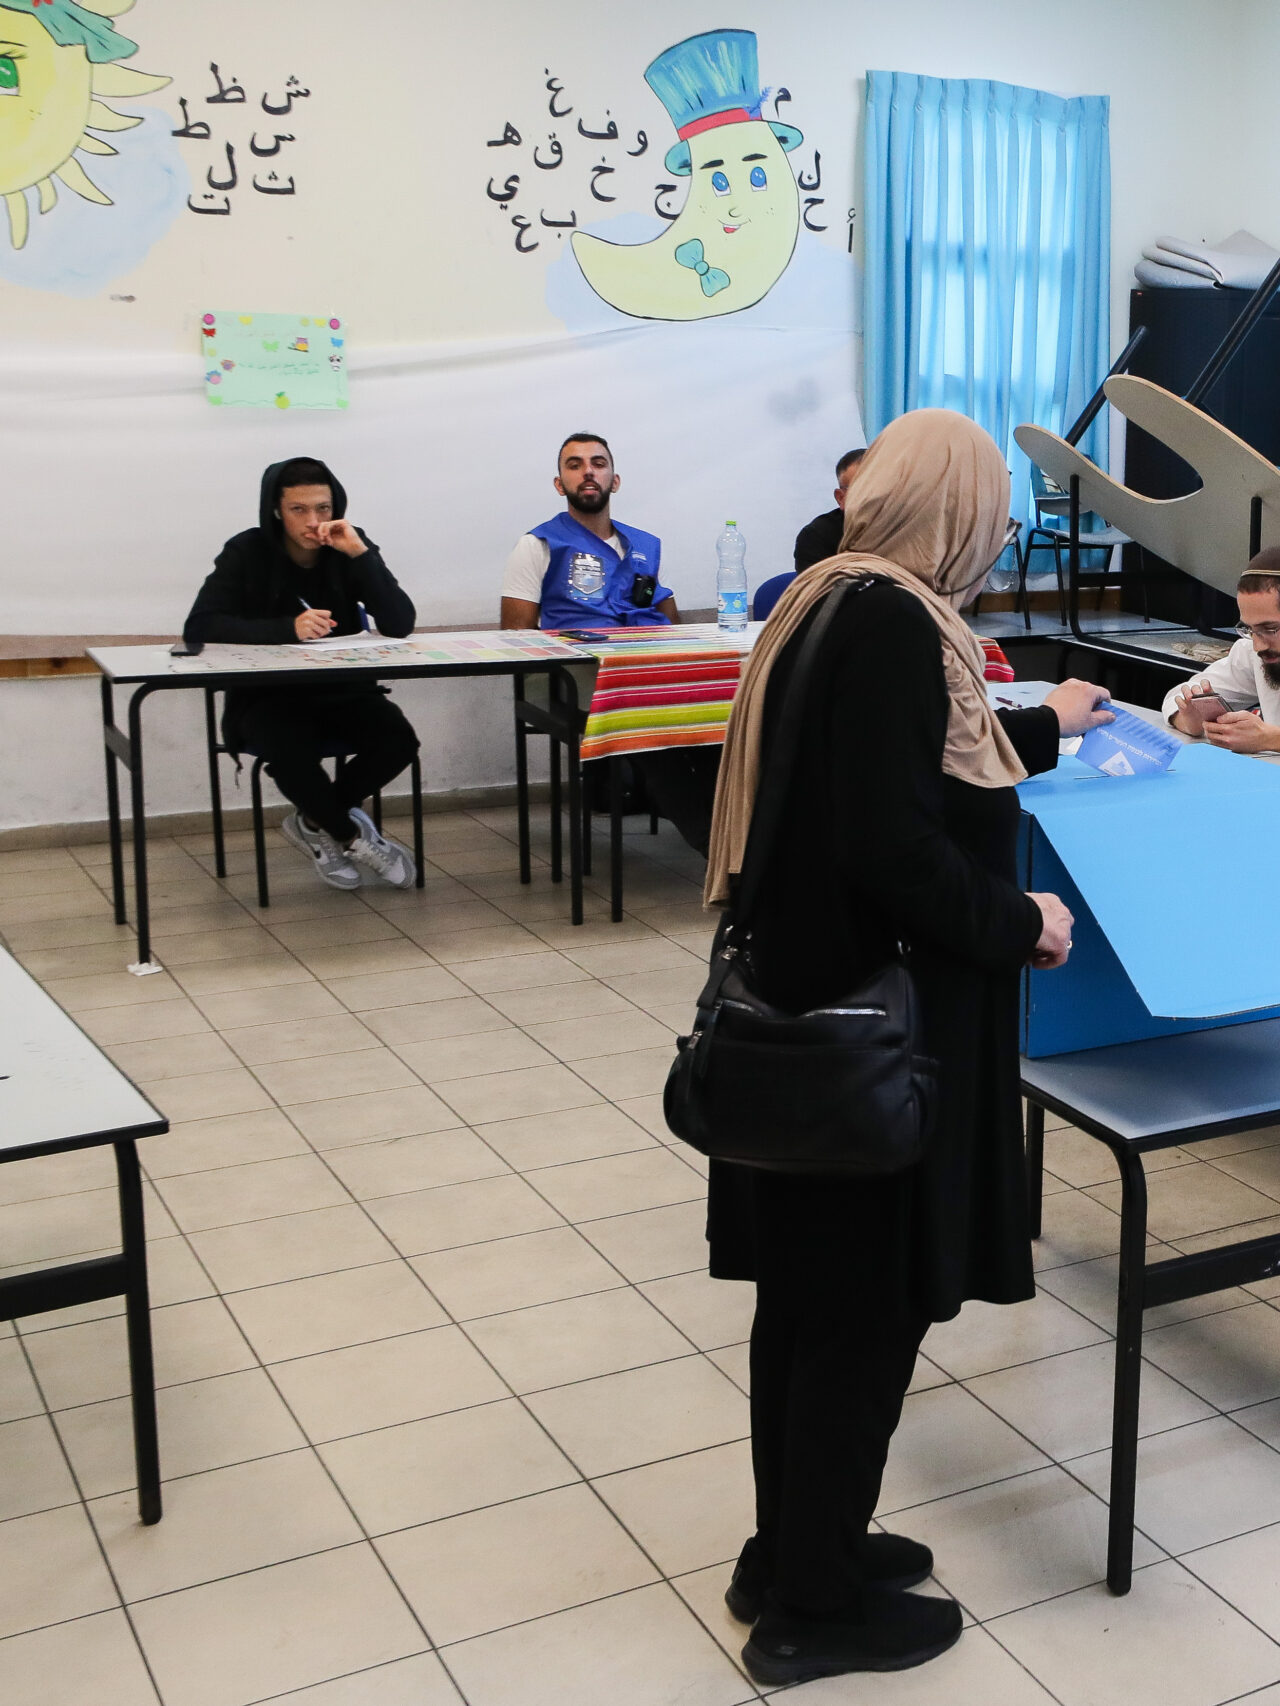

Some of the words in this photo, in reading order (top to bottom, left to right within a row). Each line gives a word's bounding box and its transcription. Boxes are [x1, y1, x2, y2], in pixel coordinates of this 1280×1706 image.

[206, 62, 246, 104] ظ
[261, 75, 311, 116] ش
[545, 67, 573, 118] غ
[171, 97, 211, 140] ط
[774, 87, 792, 119] م
[577, 109, 619, 140] ف
[250, 132, 296, 158] س
[533, 132, 563, 170] ق
[626, 130, 649, 157] و
[207, 141, 238, 191] ل
[252, 170, 296, 195] ث
[590, 156, 617, 203] خ
[187, 194, 231, 216] ت
[486, 174, 520, 211] ي
[654, 183, 681, 221] ج
[540, 208, 577, 239] ب
[803, 197, 828, 232] ح
[511, 214, 539, 254] ع
